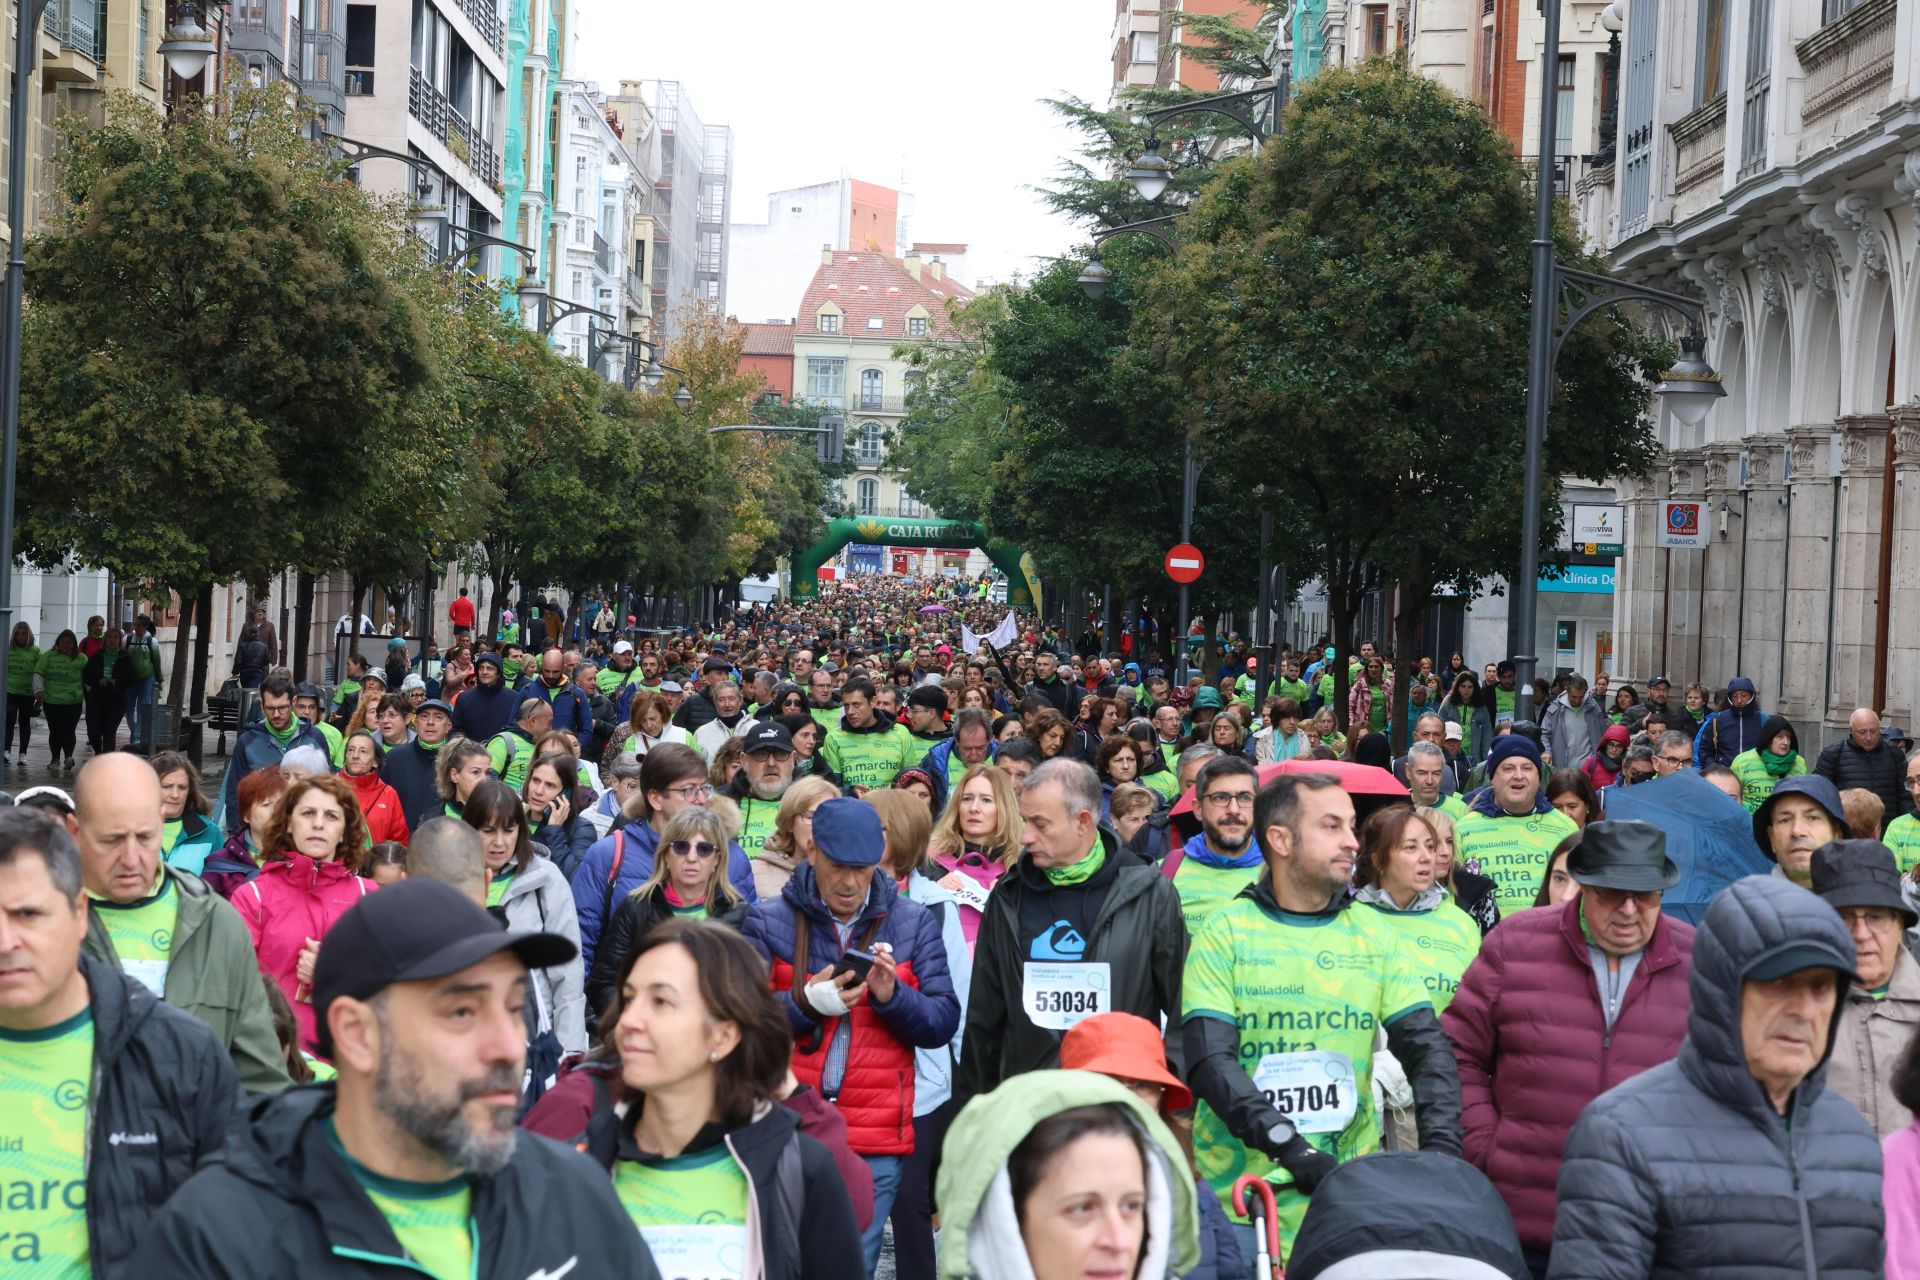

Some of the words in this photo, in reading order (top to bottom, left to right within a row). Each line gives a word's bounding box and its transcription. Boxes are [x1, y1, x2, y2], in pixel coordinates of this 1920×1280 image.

[888, 525, 922, 538] CAJA
[924, 526, 975, 540] RUL
[1563, 572, 1598, 585] Clínica
[855, 760, 898, 772] marcha
[845, 773, 877, 785] ontra
[1479, 840, 1519, 850] Valladolid
[1475, 856, 1490, 868] n
[1420, 973, 1460, 994] cha
[1245, 984, 1304, 997] Valladolid
[1035, 991, 1098, 1013] 53034
[1268, 1004, 1374, 1031] marcha
